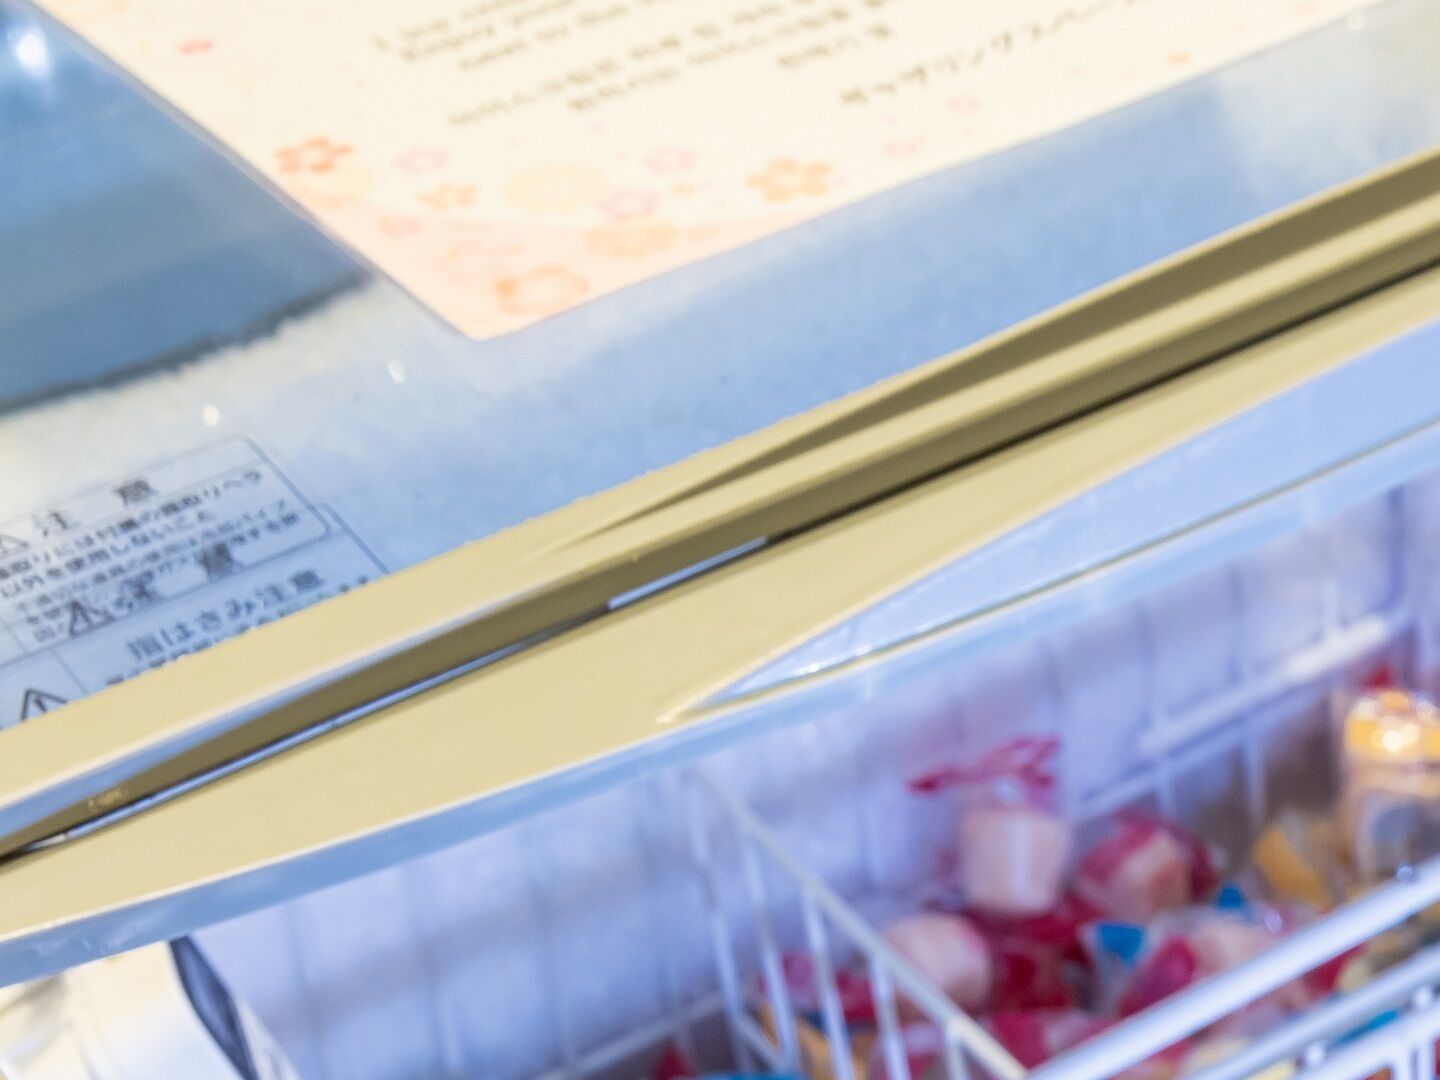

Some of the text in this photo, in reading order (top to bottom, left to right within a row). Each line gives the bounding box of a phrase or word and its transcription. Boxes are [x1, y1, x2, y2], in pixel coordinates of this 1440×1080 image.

[128, 568, 323, 660] 指はさみ注意
